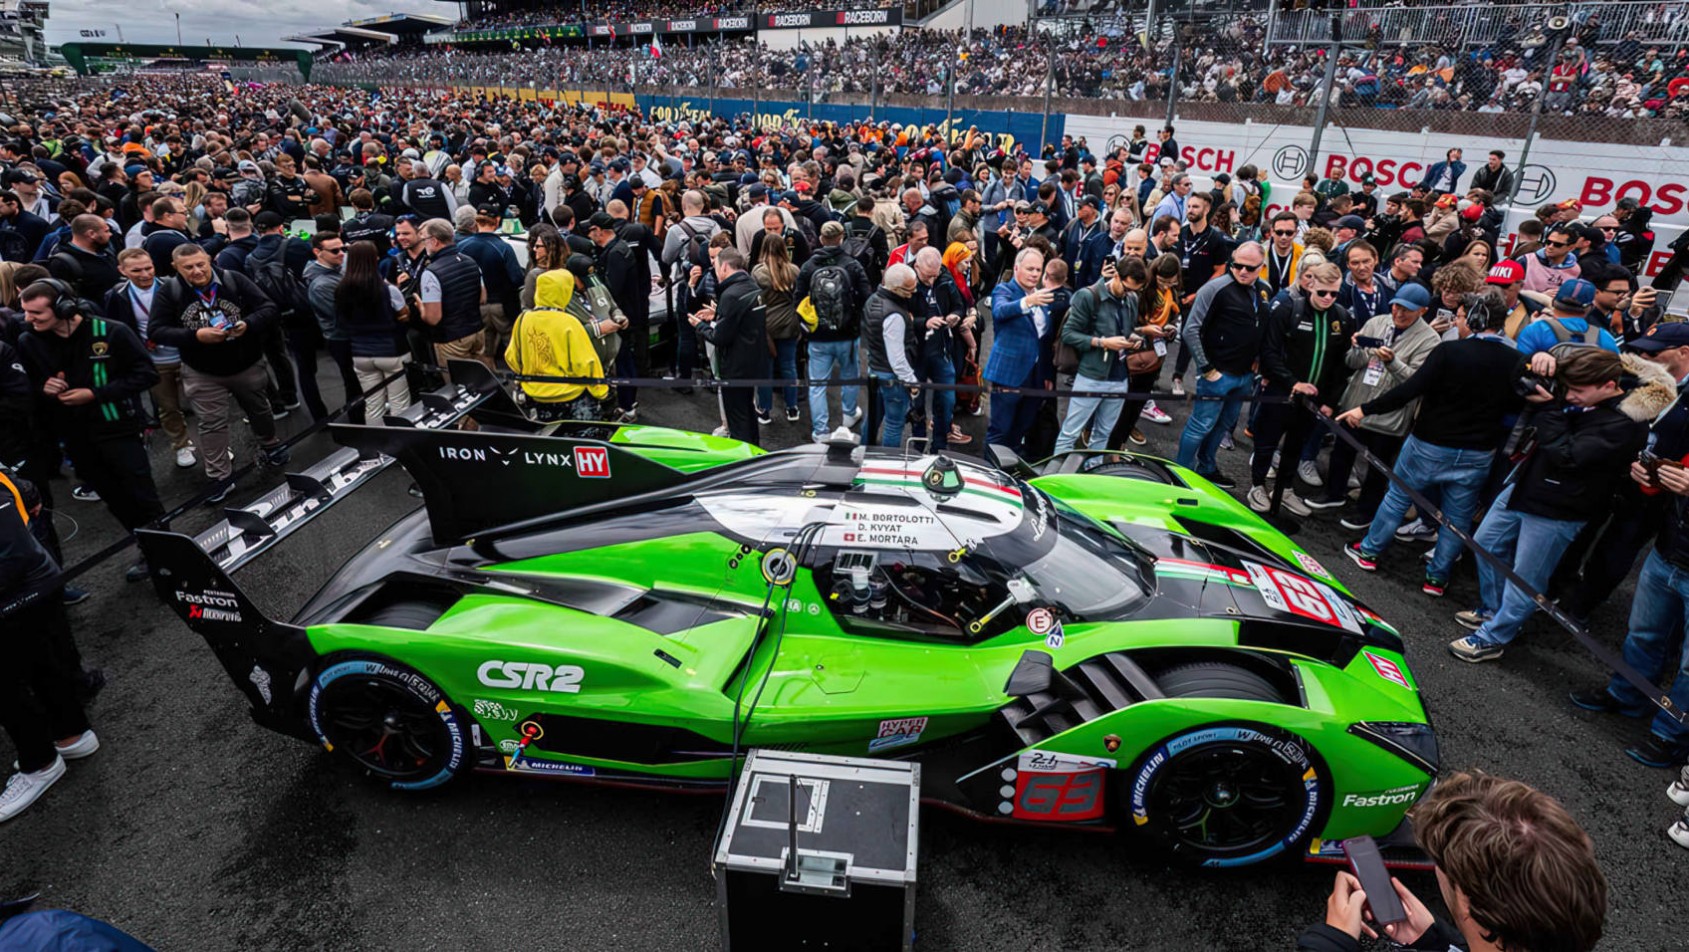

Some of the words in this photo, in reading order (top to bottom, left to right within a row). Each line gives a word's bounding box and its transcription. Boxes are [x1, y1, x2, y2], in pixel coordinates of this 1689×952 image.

[844, 11, 888, 25] RACEBORN
[1145, 143, 1235, 173] BSCH
[1324, 154, 1431, 189] BOSC
[1579, 176, 1689, 215] BOS
[439, 446, 486, 461] IRON
[524, 452, 572, 467] LYNX
[577, 452, 605, 472] HY
[858, 523, 868, 532] D.
[870, 524, 902, 532] KVYAT
[859, 513, 870, 521] M.
[872, 513, 934, 524] BORTOLOTTI
[857, 533, 867, 542] E.
[869, 534, 918, 545] MORTARA
[175, 590, 239, 608] Fastron
[1034, 615, 1045, 629] E
[477, 660, 585, 693] CSR2
[531, 762, 583, 772] MICHELIN
[1133, 752, 1165, 807] MICHELIN
[1020, 773, 1103, 815] 63
[1342, 792, 1416, 808] Fastron
